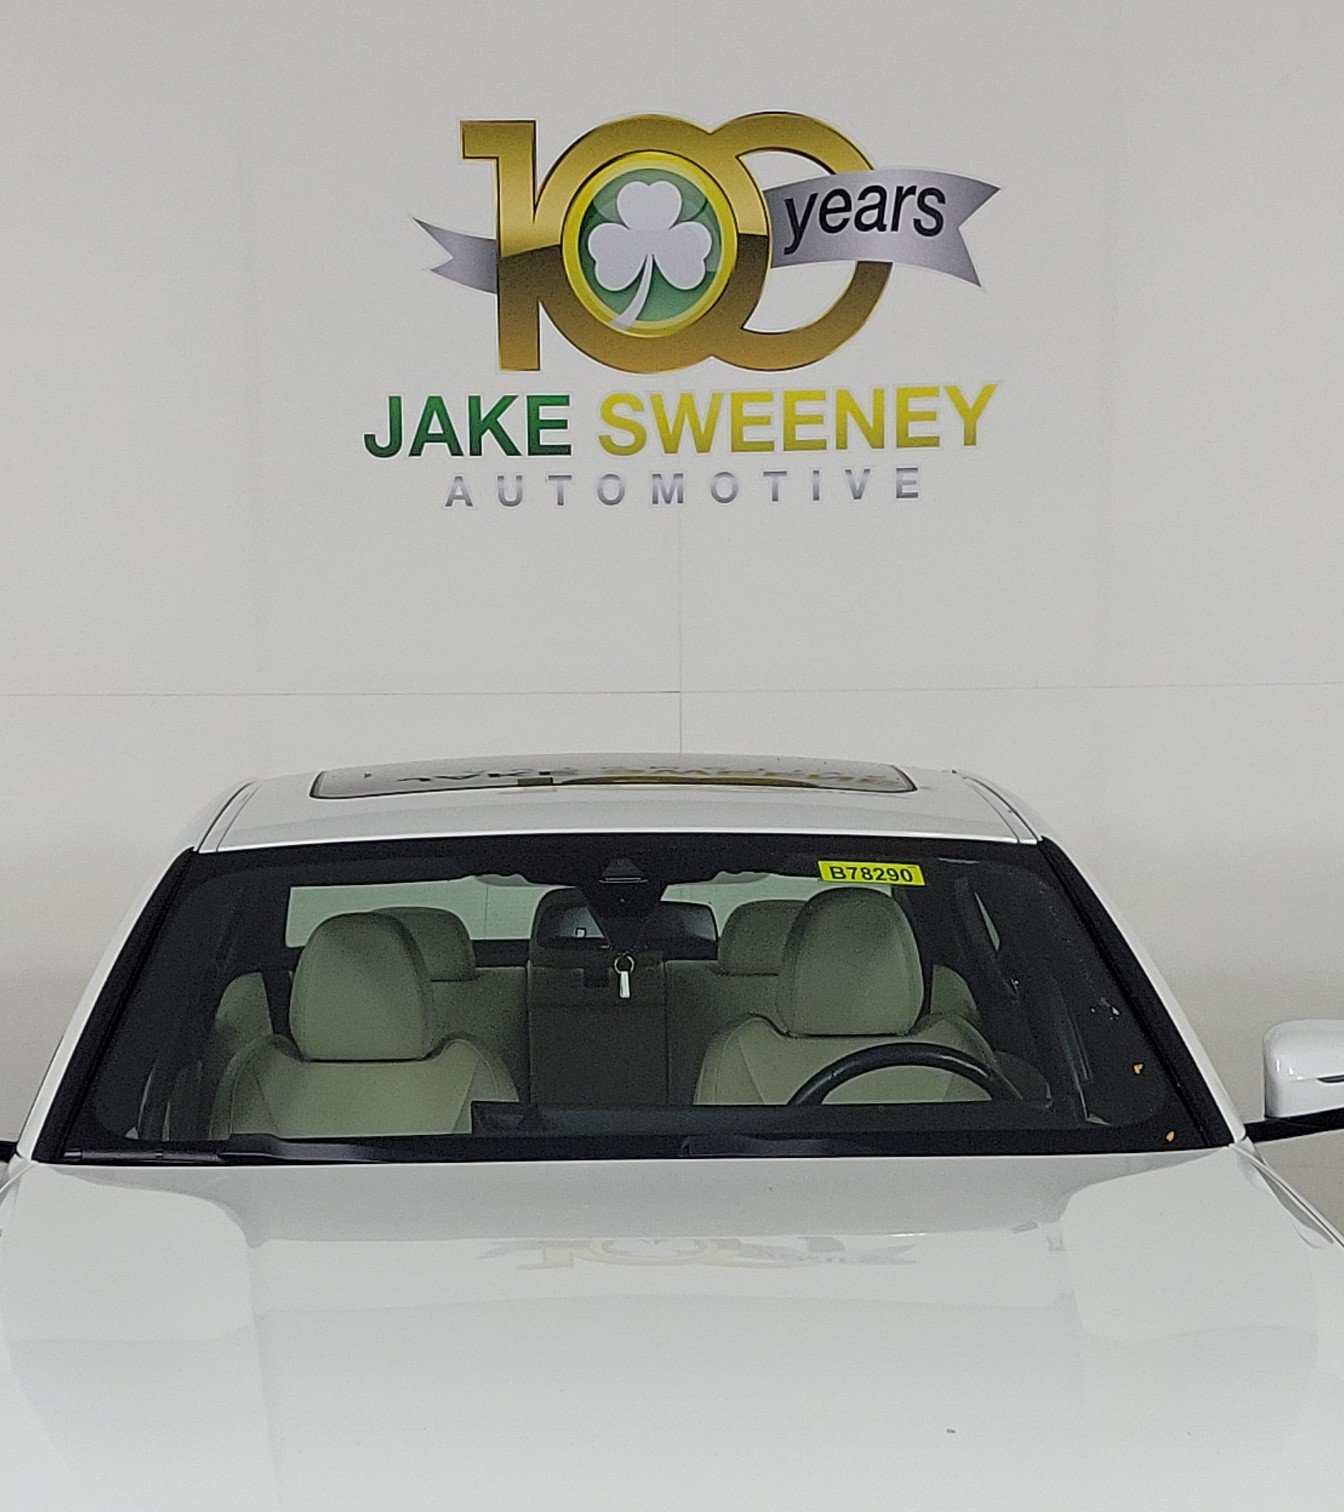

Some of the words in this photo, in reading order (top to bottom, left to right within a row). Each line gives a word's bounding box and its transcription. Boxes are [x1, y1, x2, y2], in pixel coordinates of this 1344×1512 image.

[783, 182, 947, 255] years
[363, 394, 572, 458] JAKE
[598, 383, 997, 456] SWEENEY
[445, 467, 921, 507] AUTOMOTIVE
[830, 865, 913, 882] B78290
